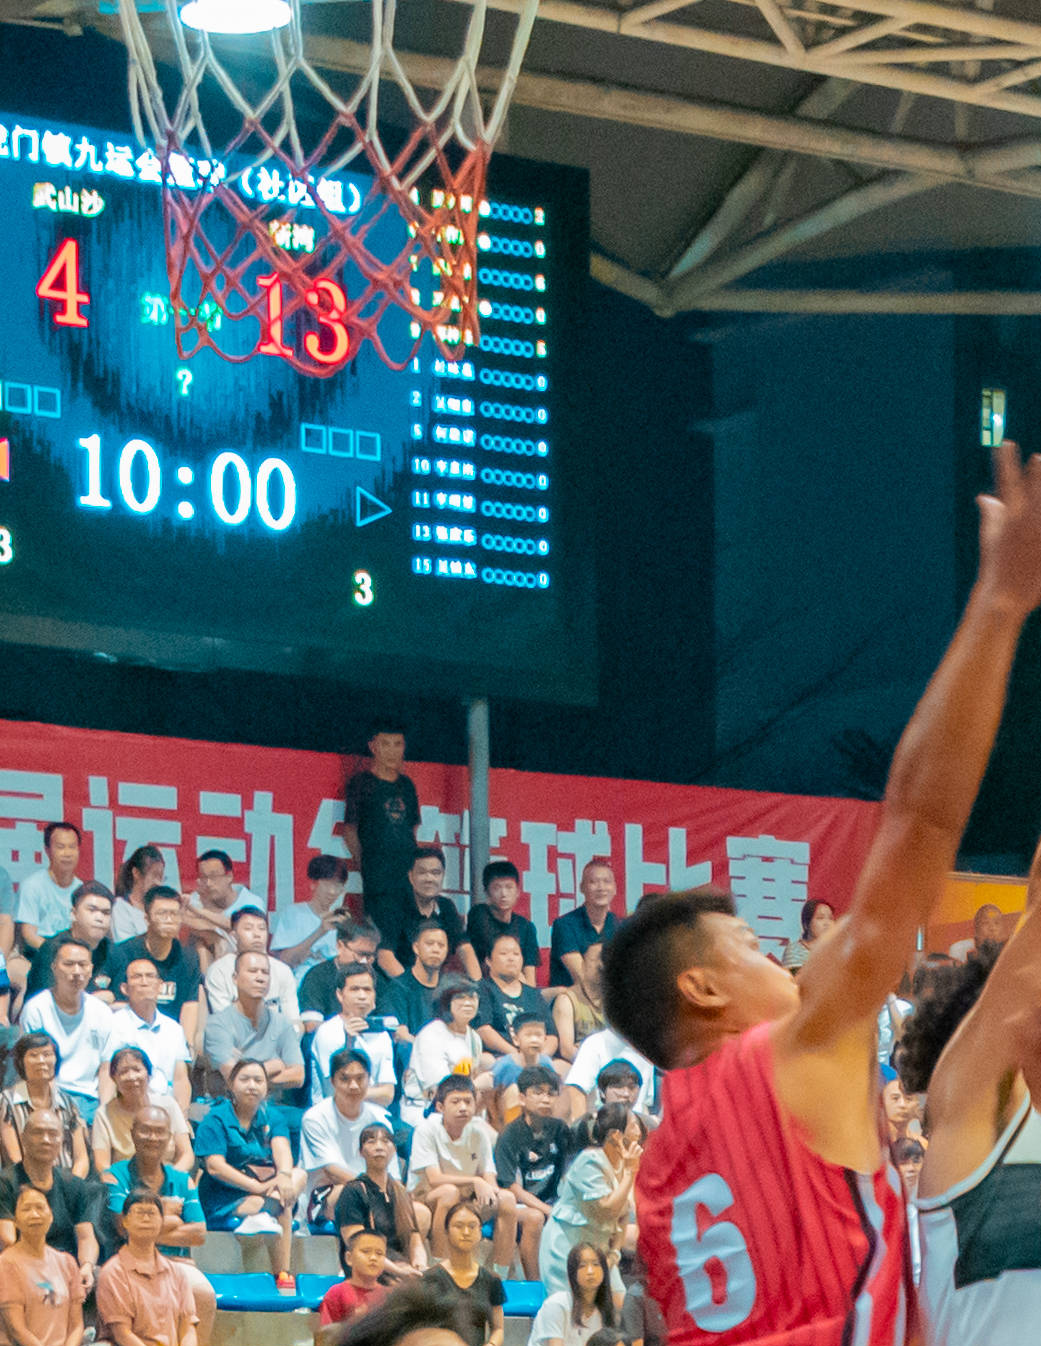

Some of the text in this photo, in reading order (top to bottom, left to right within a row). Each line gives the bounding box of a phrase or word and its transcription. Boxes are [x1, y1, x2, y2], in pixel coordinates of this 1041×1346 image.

[36, 238, 90, 328] 4
[256, 272, 350, 365] 13
[77, 432, 297, 532] 10:00
[412, 456, 431, 476] 10
[412, 489, 431, 508] 11
[537, 506, 550, 523] 0
[412, 523, 432, 543] 13
[537, 539, 550, 557] 0
[353, 568, 375, 607] 3
[412, 556, 433, 575] 15
[537, 572, 550, 590] 0
[669, 1172, 757, 1333] 6
